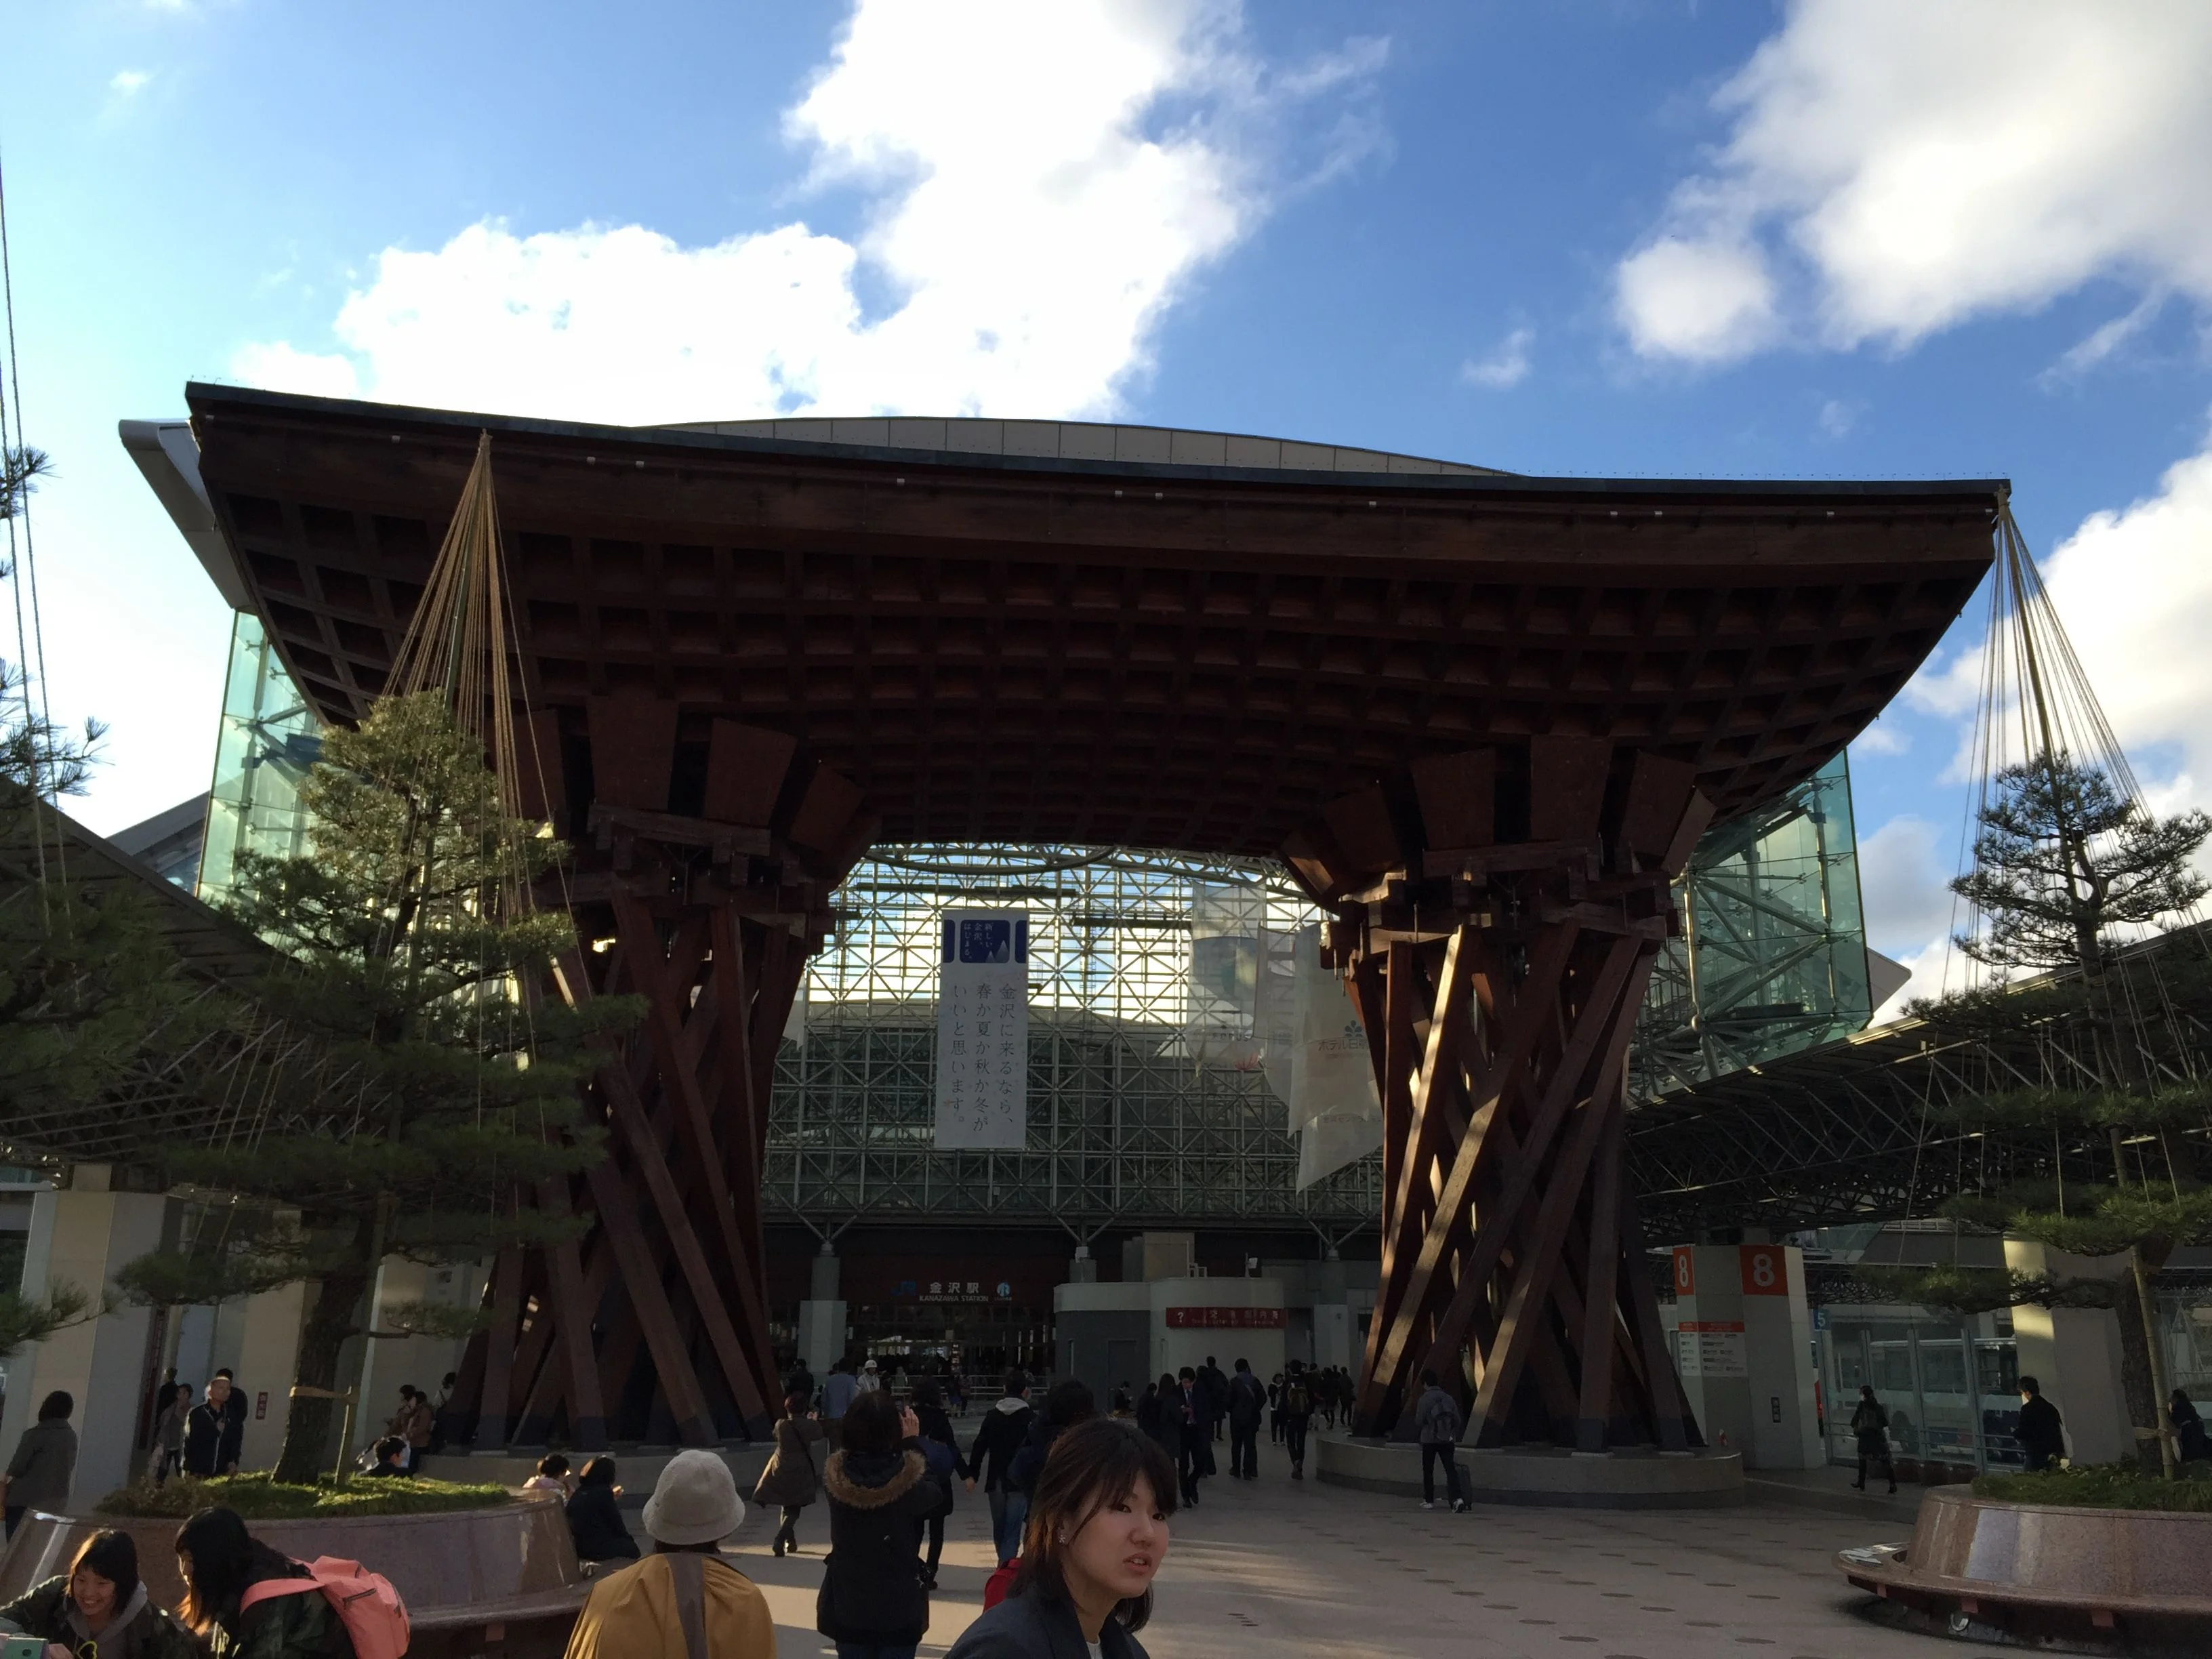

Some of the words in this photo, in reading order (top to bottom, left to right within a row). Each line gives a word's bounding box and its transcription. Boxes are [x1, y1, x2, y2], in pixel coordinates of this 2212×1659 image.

[950, 984, 968, 1122] いいと思います。
[972, 983, 992, 1132] 春か夏か秋か冬が
[998, 983, 1017, 1123] 金沢に来るなら、
[1678, 1254, 1689, 1288] 8
[1753, 1253, 1775, 1287] 8
[890, 1281, 917, 1296] JR
[929, 1282, 979, 1294] 金沢駅
[1818, 1312, 1826, 1327] 5
